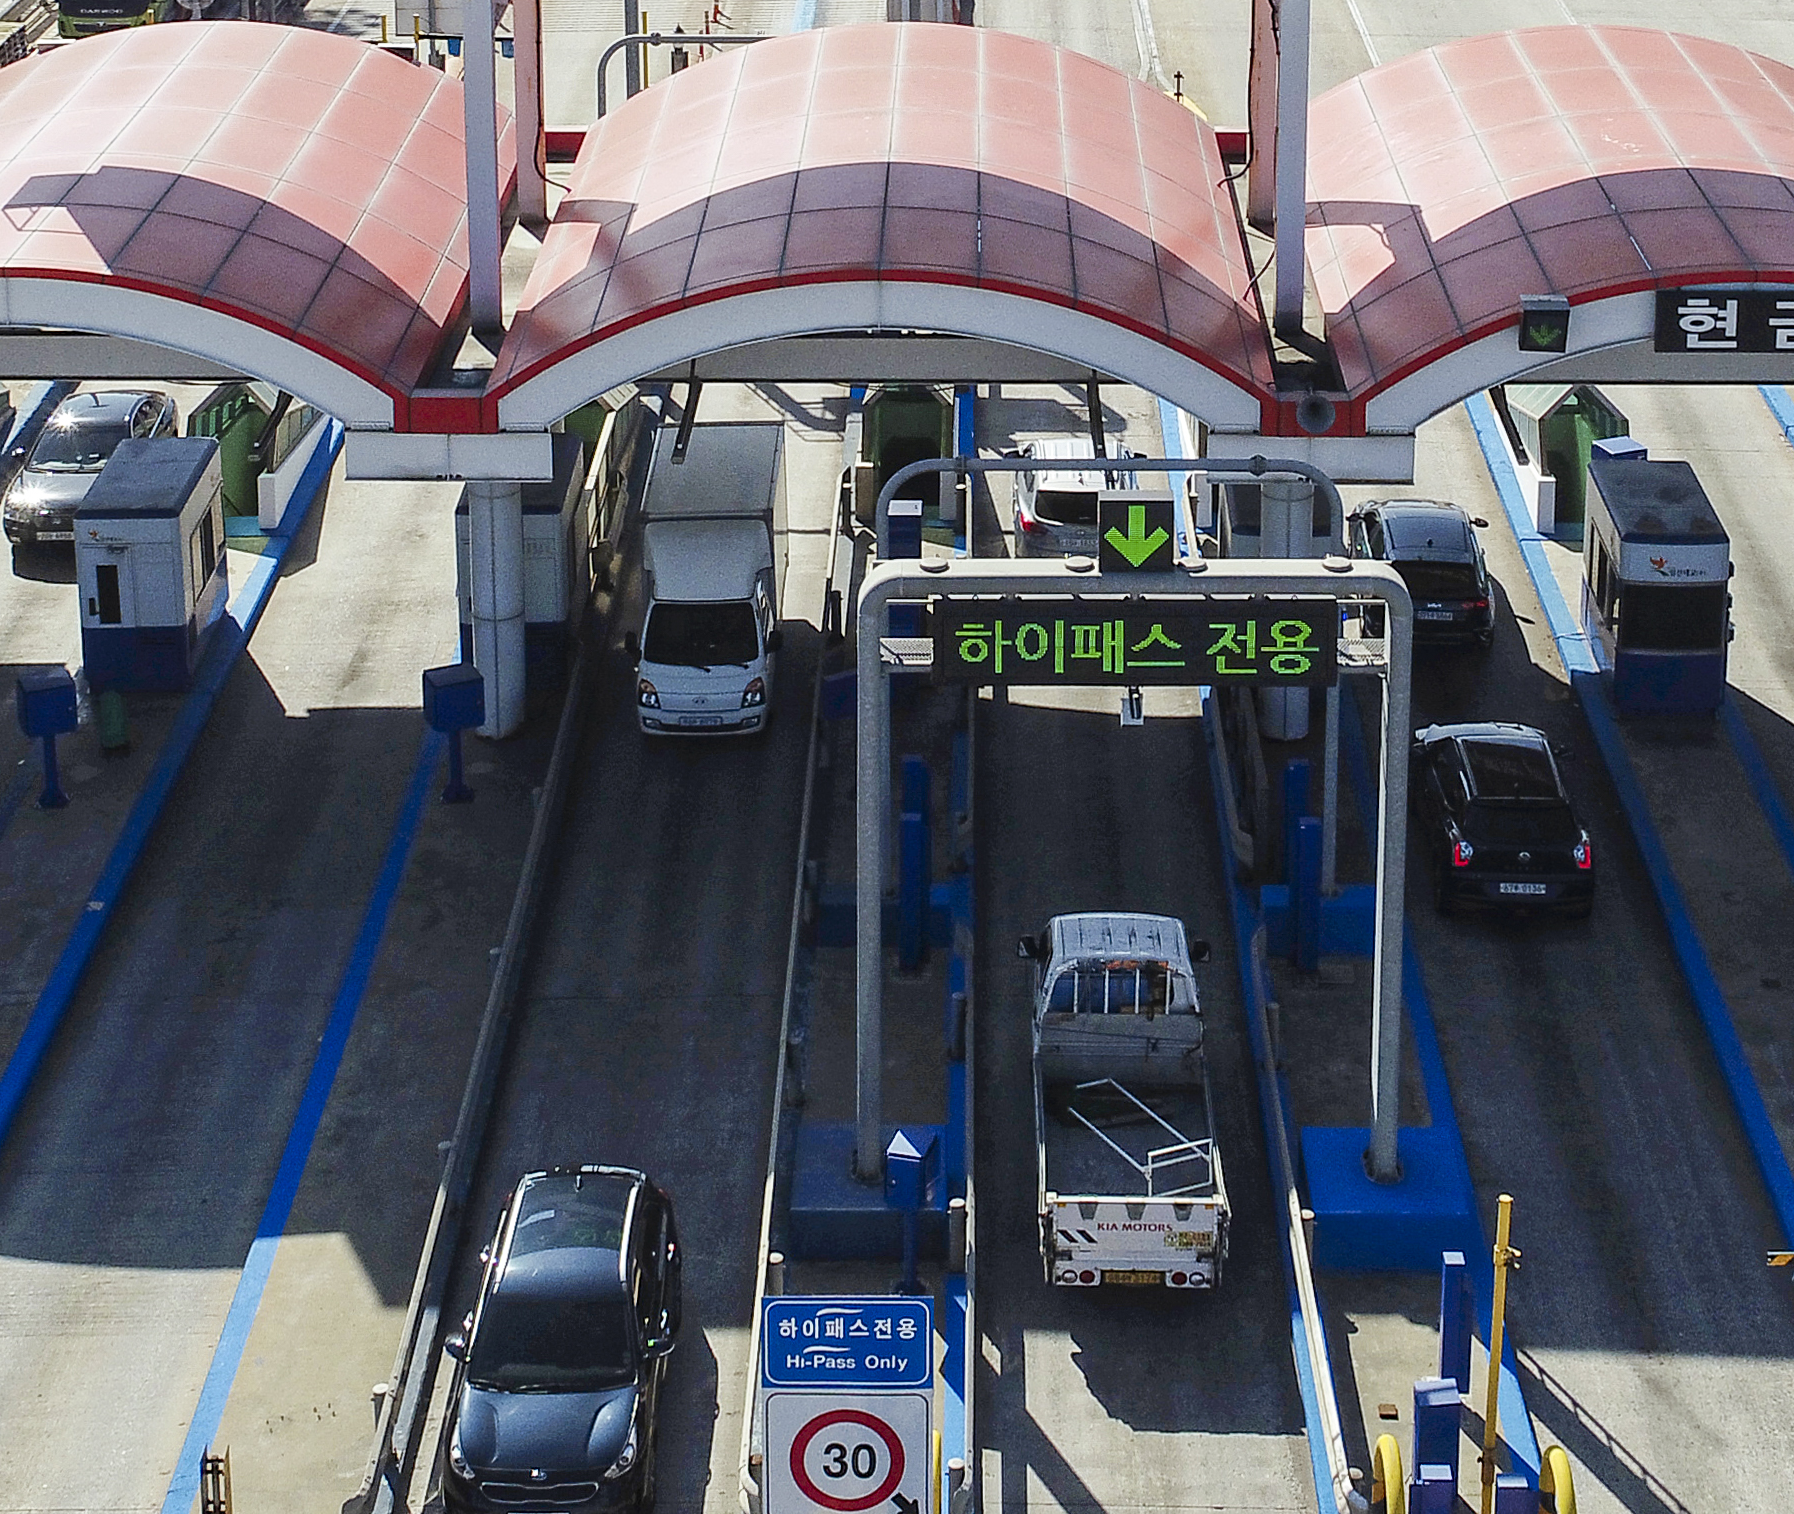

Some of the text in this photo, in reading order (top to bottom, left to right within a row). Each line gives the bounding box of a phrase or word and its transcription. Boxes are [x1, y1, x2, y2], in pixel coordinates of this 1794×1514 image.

[955, 619, 1320, 675] 하이패스 전용
[1096, 1222, 1173, 1232] KIA MOTORS
[778, 1317, 918, 1340] 하이패스전용
[786, 1354, 908, 1372] Hi-Pass Only
[822, 1442, 877, 1479] 30
